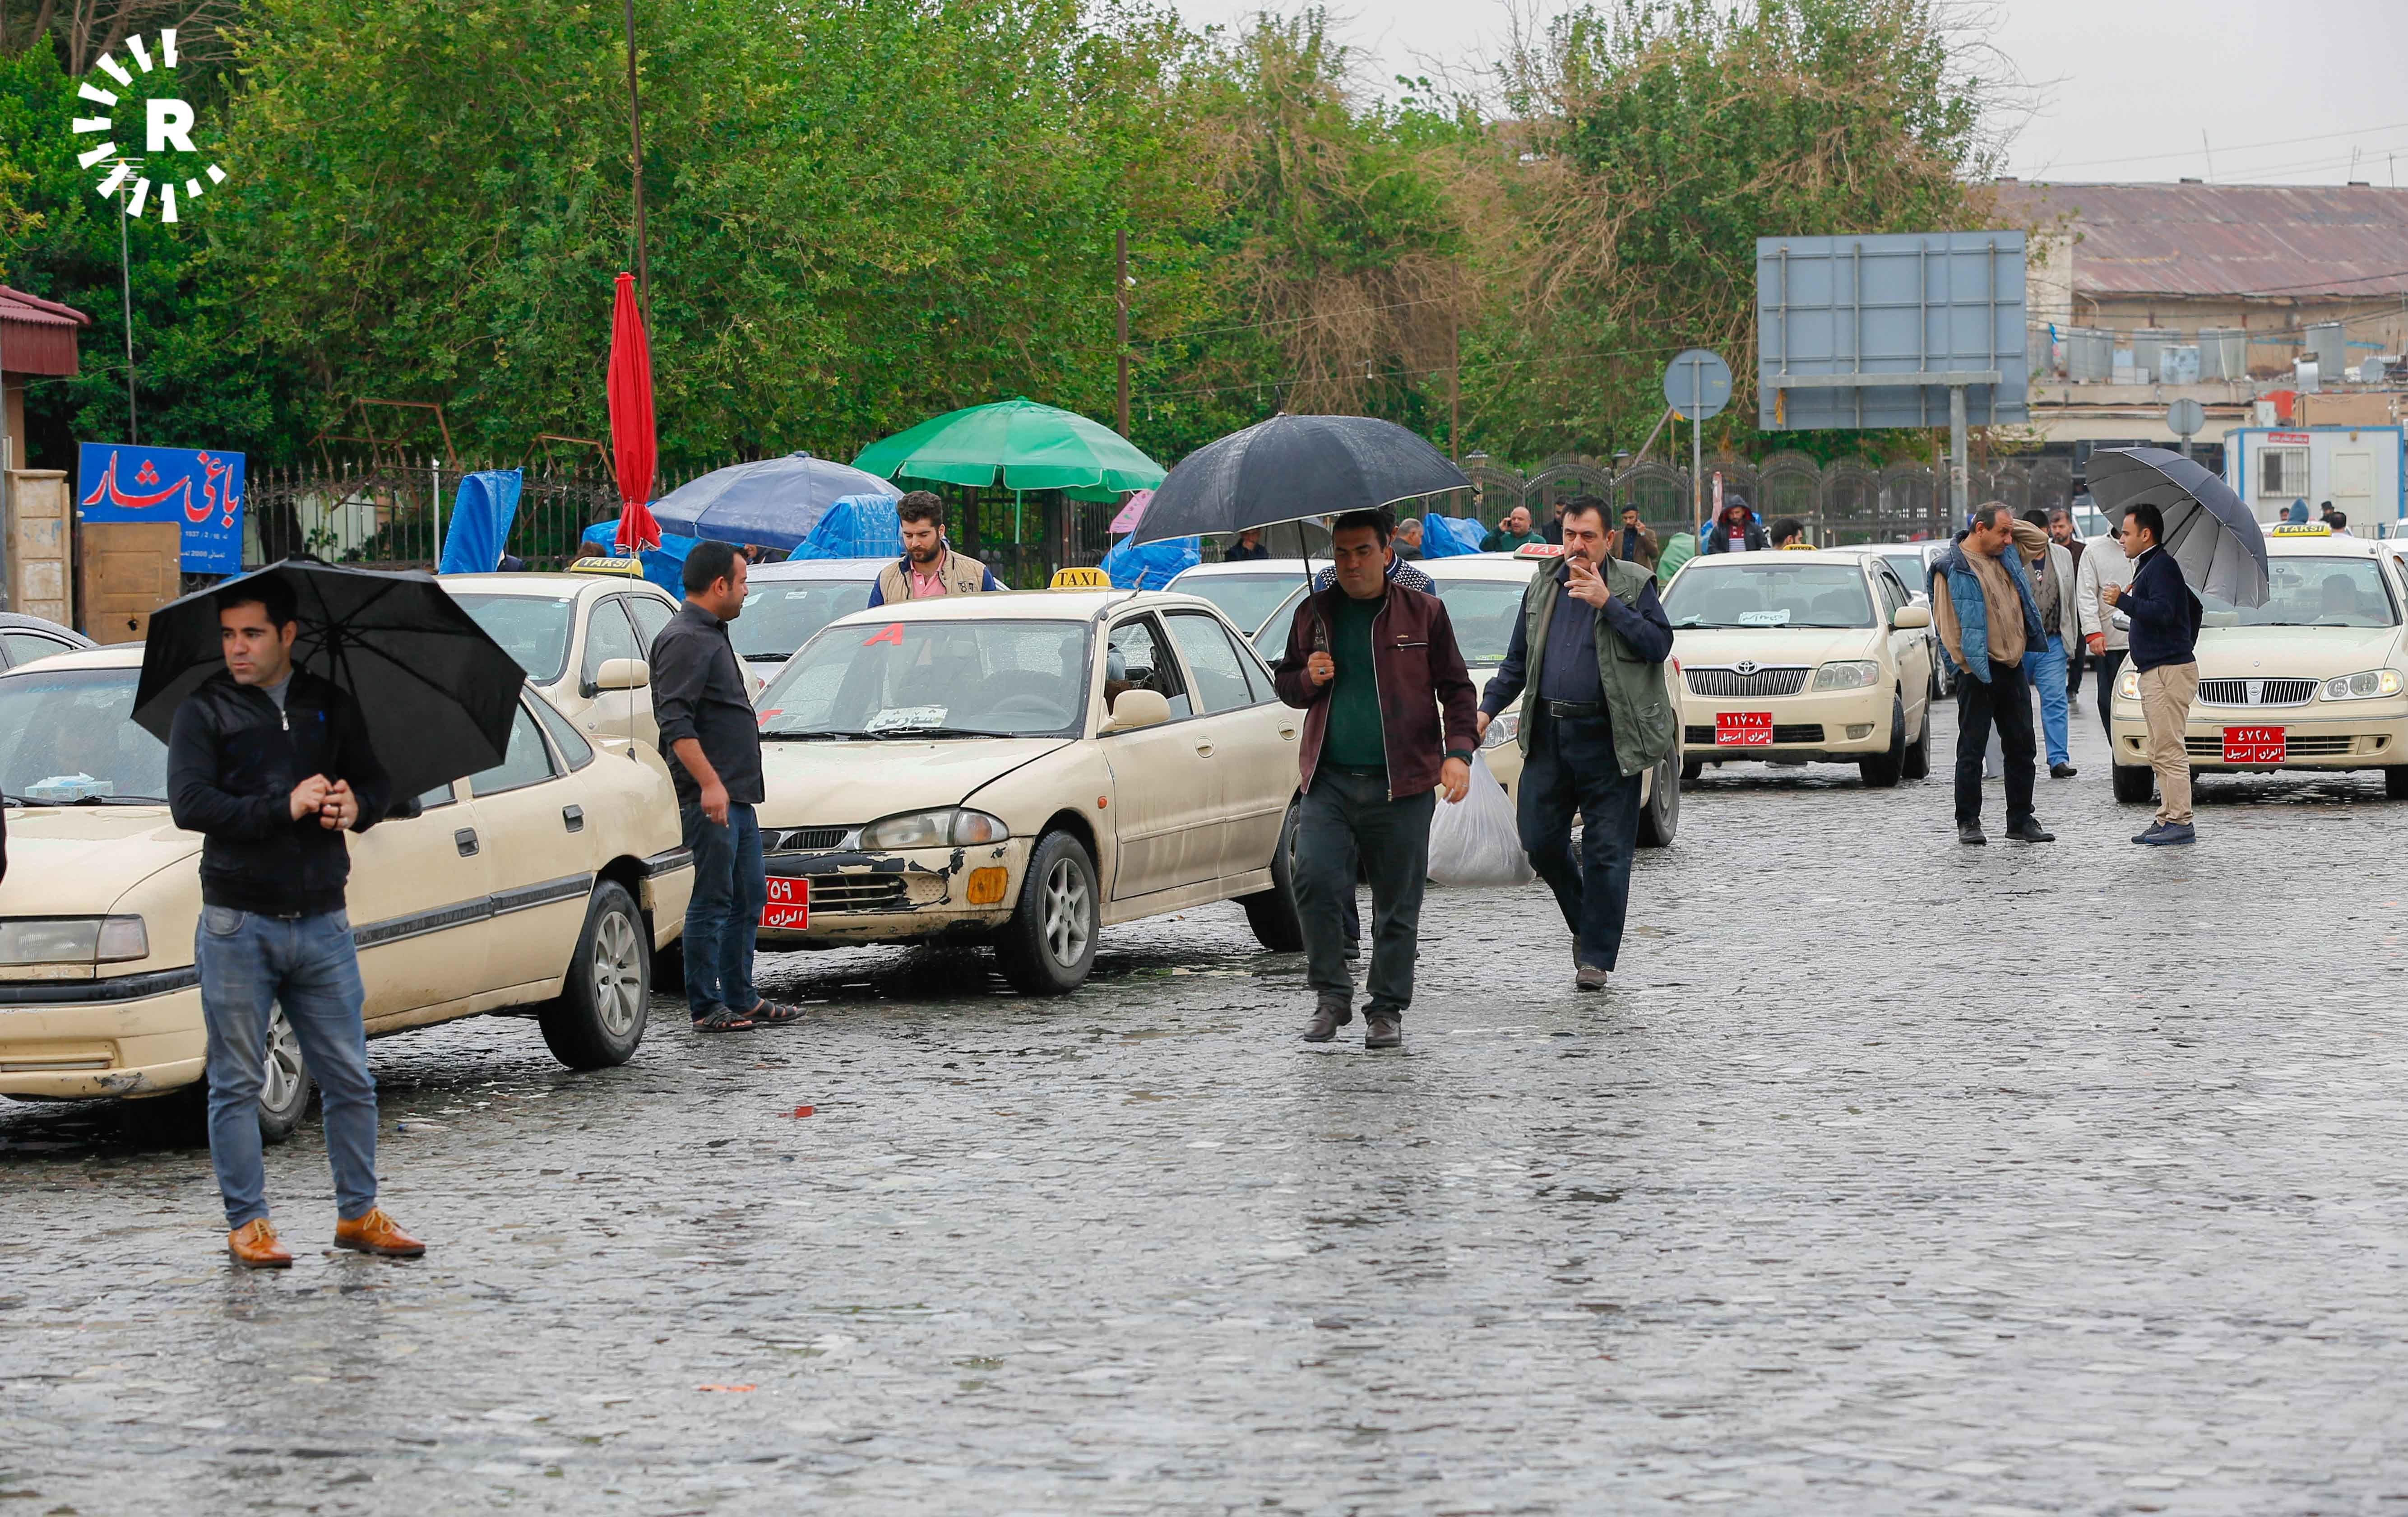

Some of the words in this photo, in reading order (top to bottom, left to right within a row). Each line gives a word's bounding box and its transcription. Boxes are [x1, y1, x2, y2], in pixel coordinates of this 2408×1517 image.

[82, 450, 190, 509] شار
[1528, 545, 1563, 555] TAX
[1058, 572, 1097, 585] TAXI
[862, 623, 904, 646] A
[1748, 731, 1768, 742] العراق
[2238, 730, 2270, 741] ٤٧٢٨
[2258, 748, 2281, 759] العراق
[769, 909, 803, 926] العراق
